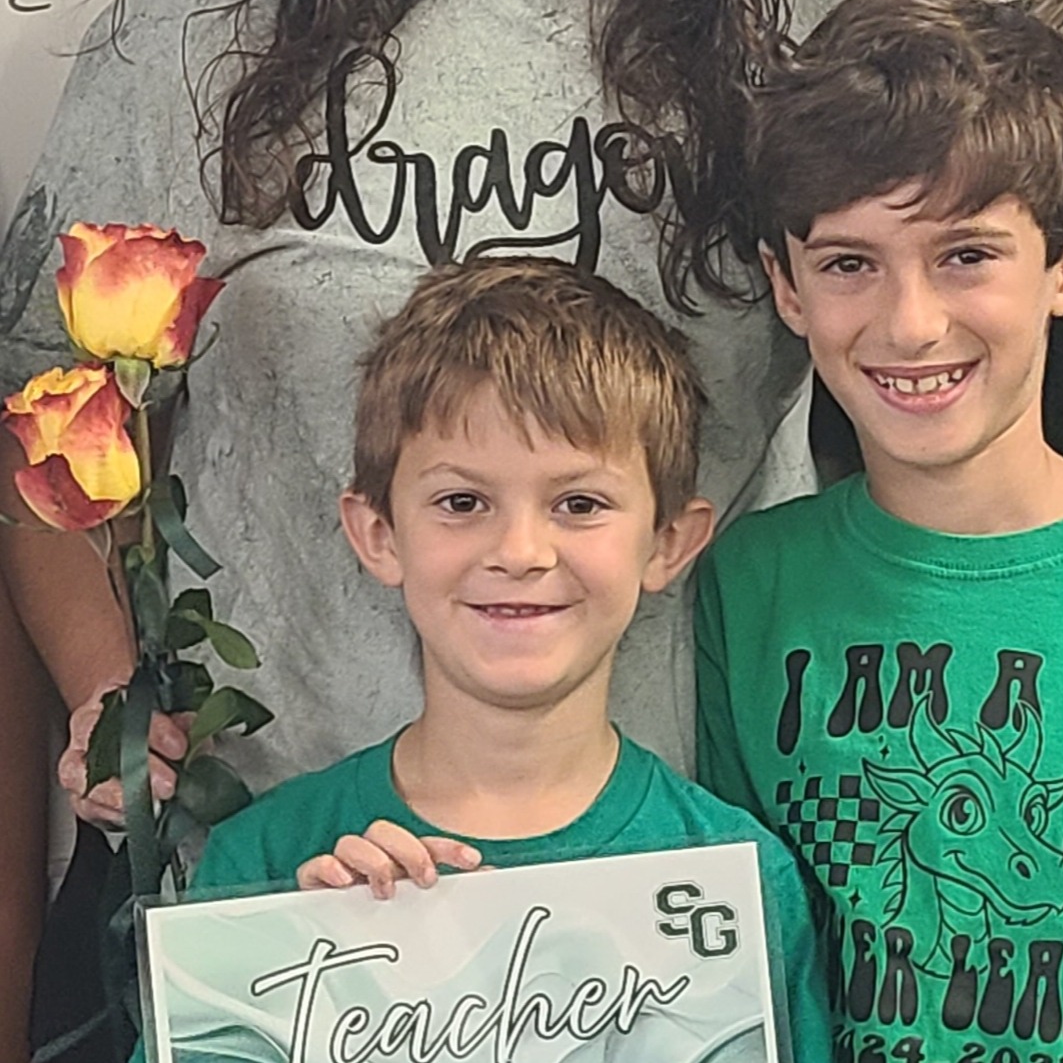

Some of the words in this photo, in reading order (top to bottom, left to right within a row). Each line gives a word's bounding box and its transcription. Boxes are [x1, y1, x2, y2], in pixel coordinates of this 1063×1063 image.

[289, 46, 668, 277] drago
[777, 648, 811, 756] I
[826, 641, 954, 738] AM
[979, 648, 1044, 732] A
[251, 905, 691, 1063] Teacher
[653, 880, 740, 960] SG
